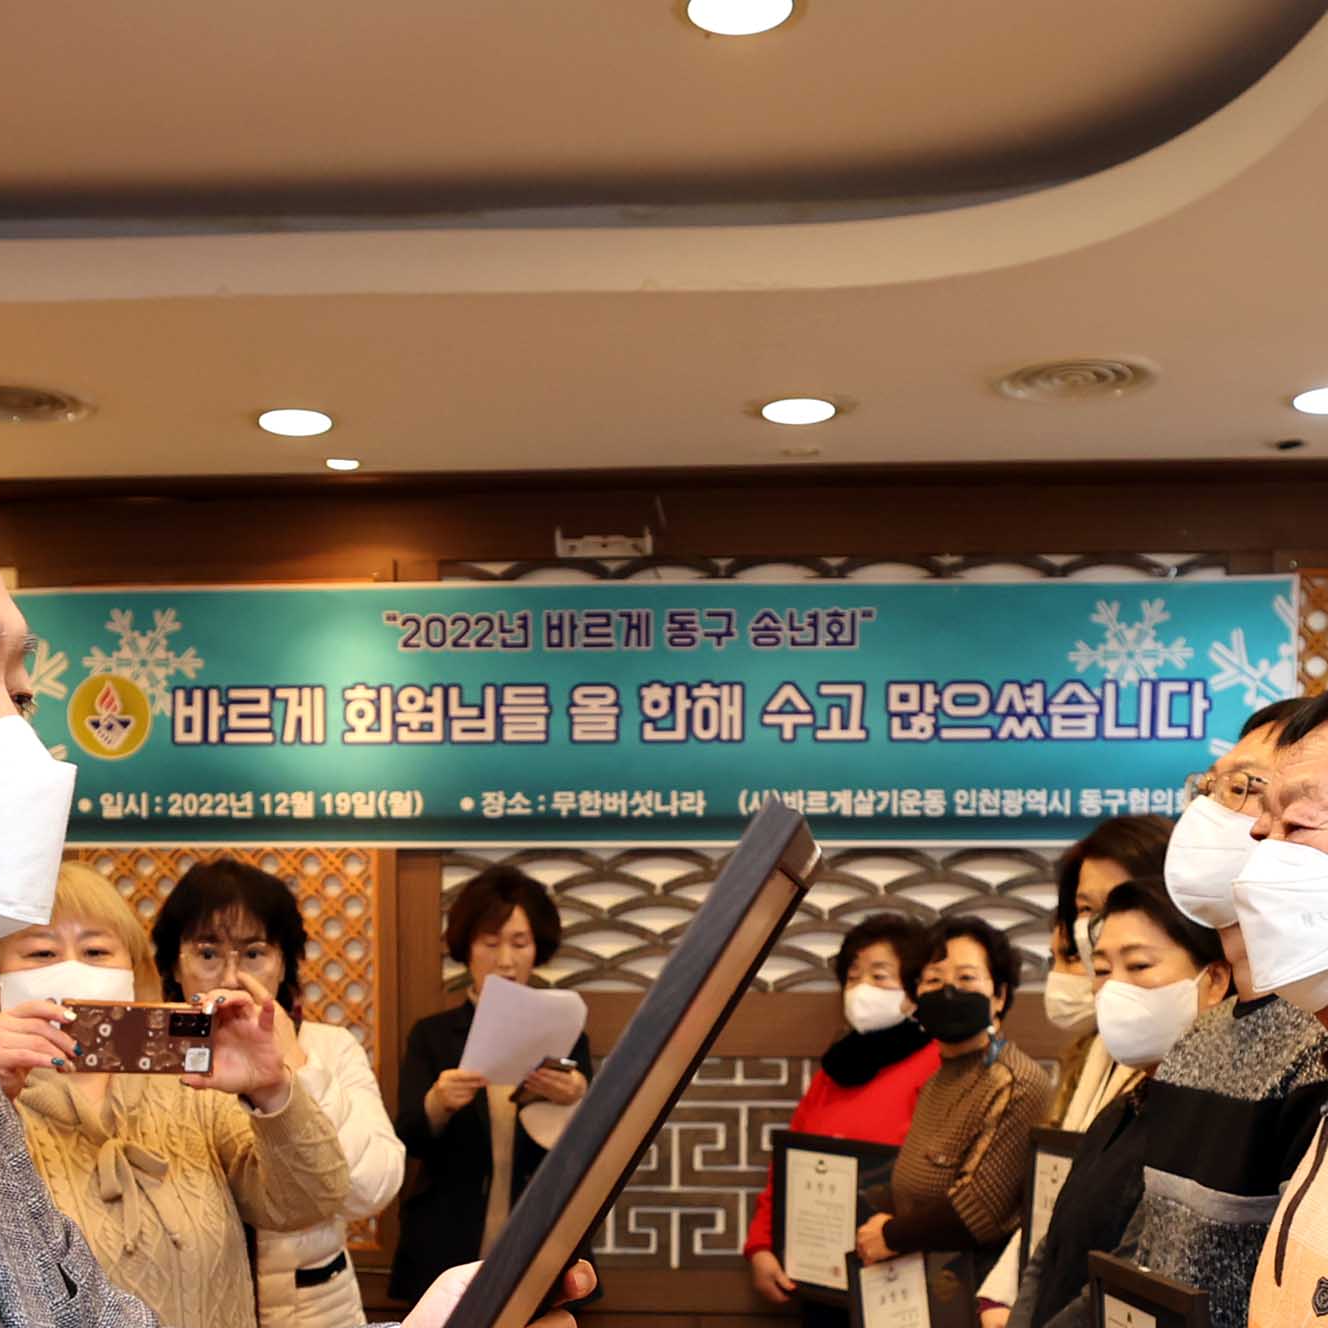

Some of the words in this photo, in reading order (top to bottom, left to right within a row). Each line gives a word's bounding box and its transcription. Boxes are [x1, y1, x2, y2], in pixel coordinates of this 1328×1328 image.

[545, 610, 652, 649] 바르게
[666, 609, 736, 648] 동구
[173, 685, 327, 745] 바르게
[343, 682, 550, 745] 회원님들
[568, 682, 621, 744] 올
[639, 681, 744, 743] 한해
[761, 681, 867, 743] 수고
[885, 680, 1212, 742] 많으셨습니다
[99, 791, 148, 819] 일시
[167, 791, 253, 819] 2022년
[260, 791, 315, 819] 12월
[321, 790, 424, 819] 19일(월)
[481, 790, 533, 818] 장소
[551, 790, 707, 817] 무한버섯나라
[954, 788, 1072, 817] 인천광역시
